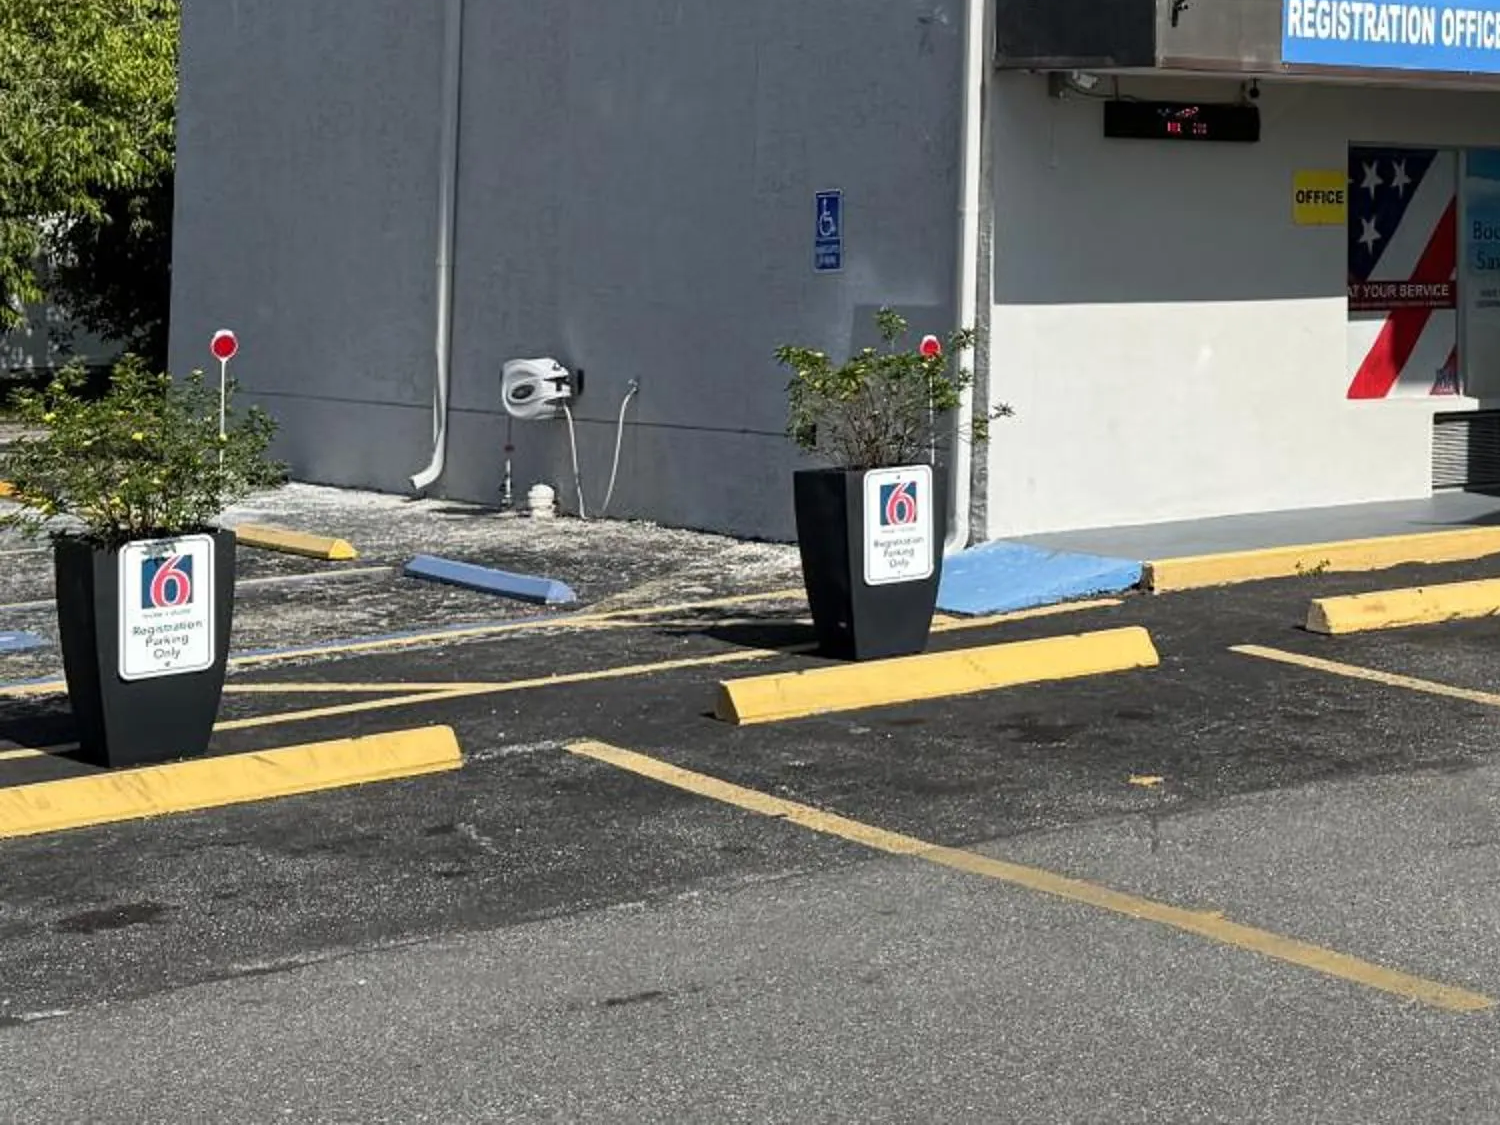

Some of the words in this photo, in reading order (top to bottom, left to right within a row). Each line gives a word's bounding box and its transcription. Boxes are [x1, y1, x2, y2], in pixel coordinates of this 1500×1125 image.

[1295, 190, 1345, 204] OFFICE
[1363, 283, 1397, 298] YOUR
[1399, 283, 1450, 297] SERVICE
[885, 481, 916, 525] 6
[873, 536, 925, 549] Registration
[883, 548, 915, 558] Parking
[888, 558, 910, 569] Only
[149, 553, 191, 607] 6
[132, 619, 204, 636] Registration
[144, 634, 190, 648] Parking
[153, 647, 181, 660] Only
